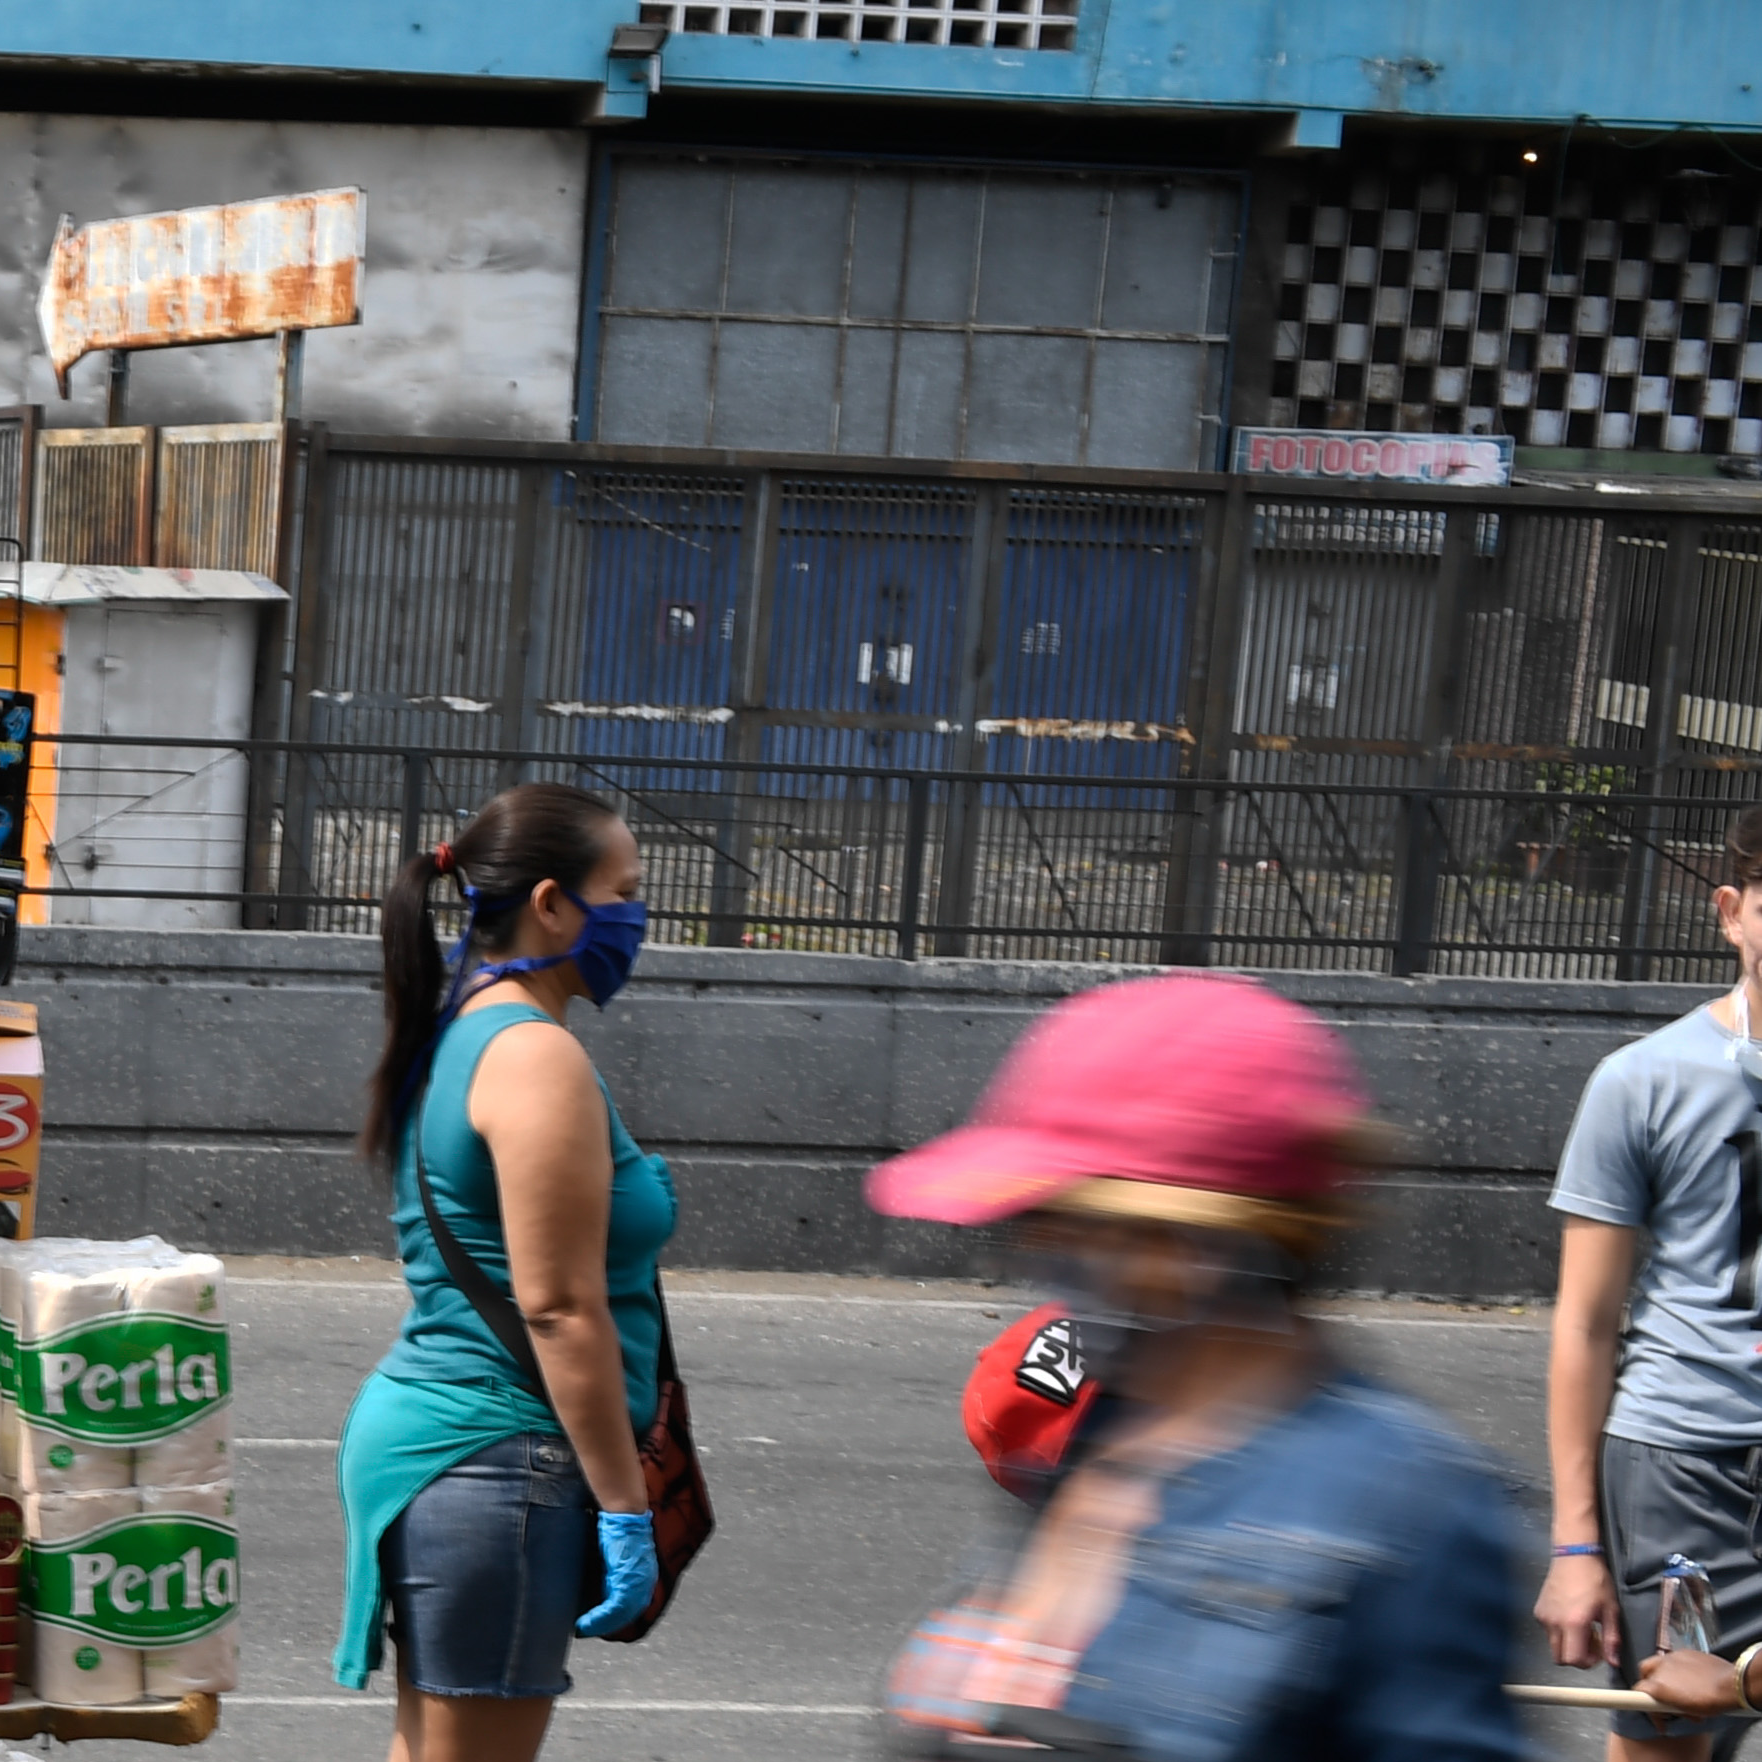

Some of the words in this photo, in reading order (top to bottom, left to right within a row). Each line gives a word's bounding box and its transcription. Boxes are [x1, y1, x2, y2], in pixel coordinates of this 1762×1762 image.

[1247, 434, 1503, 479] FOTOCOPIAS
[38, 1342, 220, 1417] Perla
[69, 1546, 238, 1618] Perla
